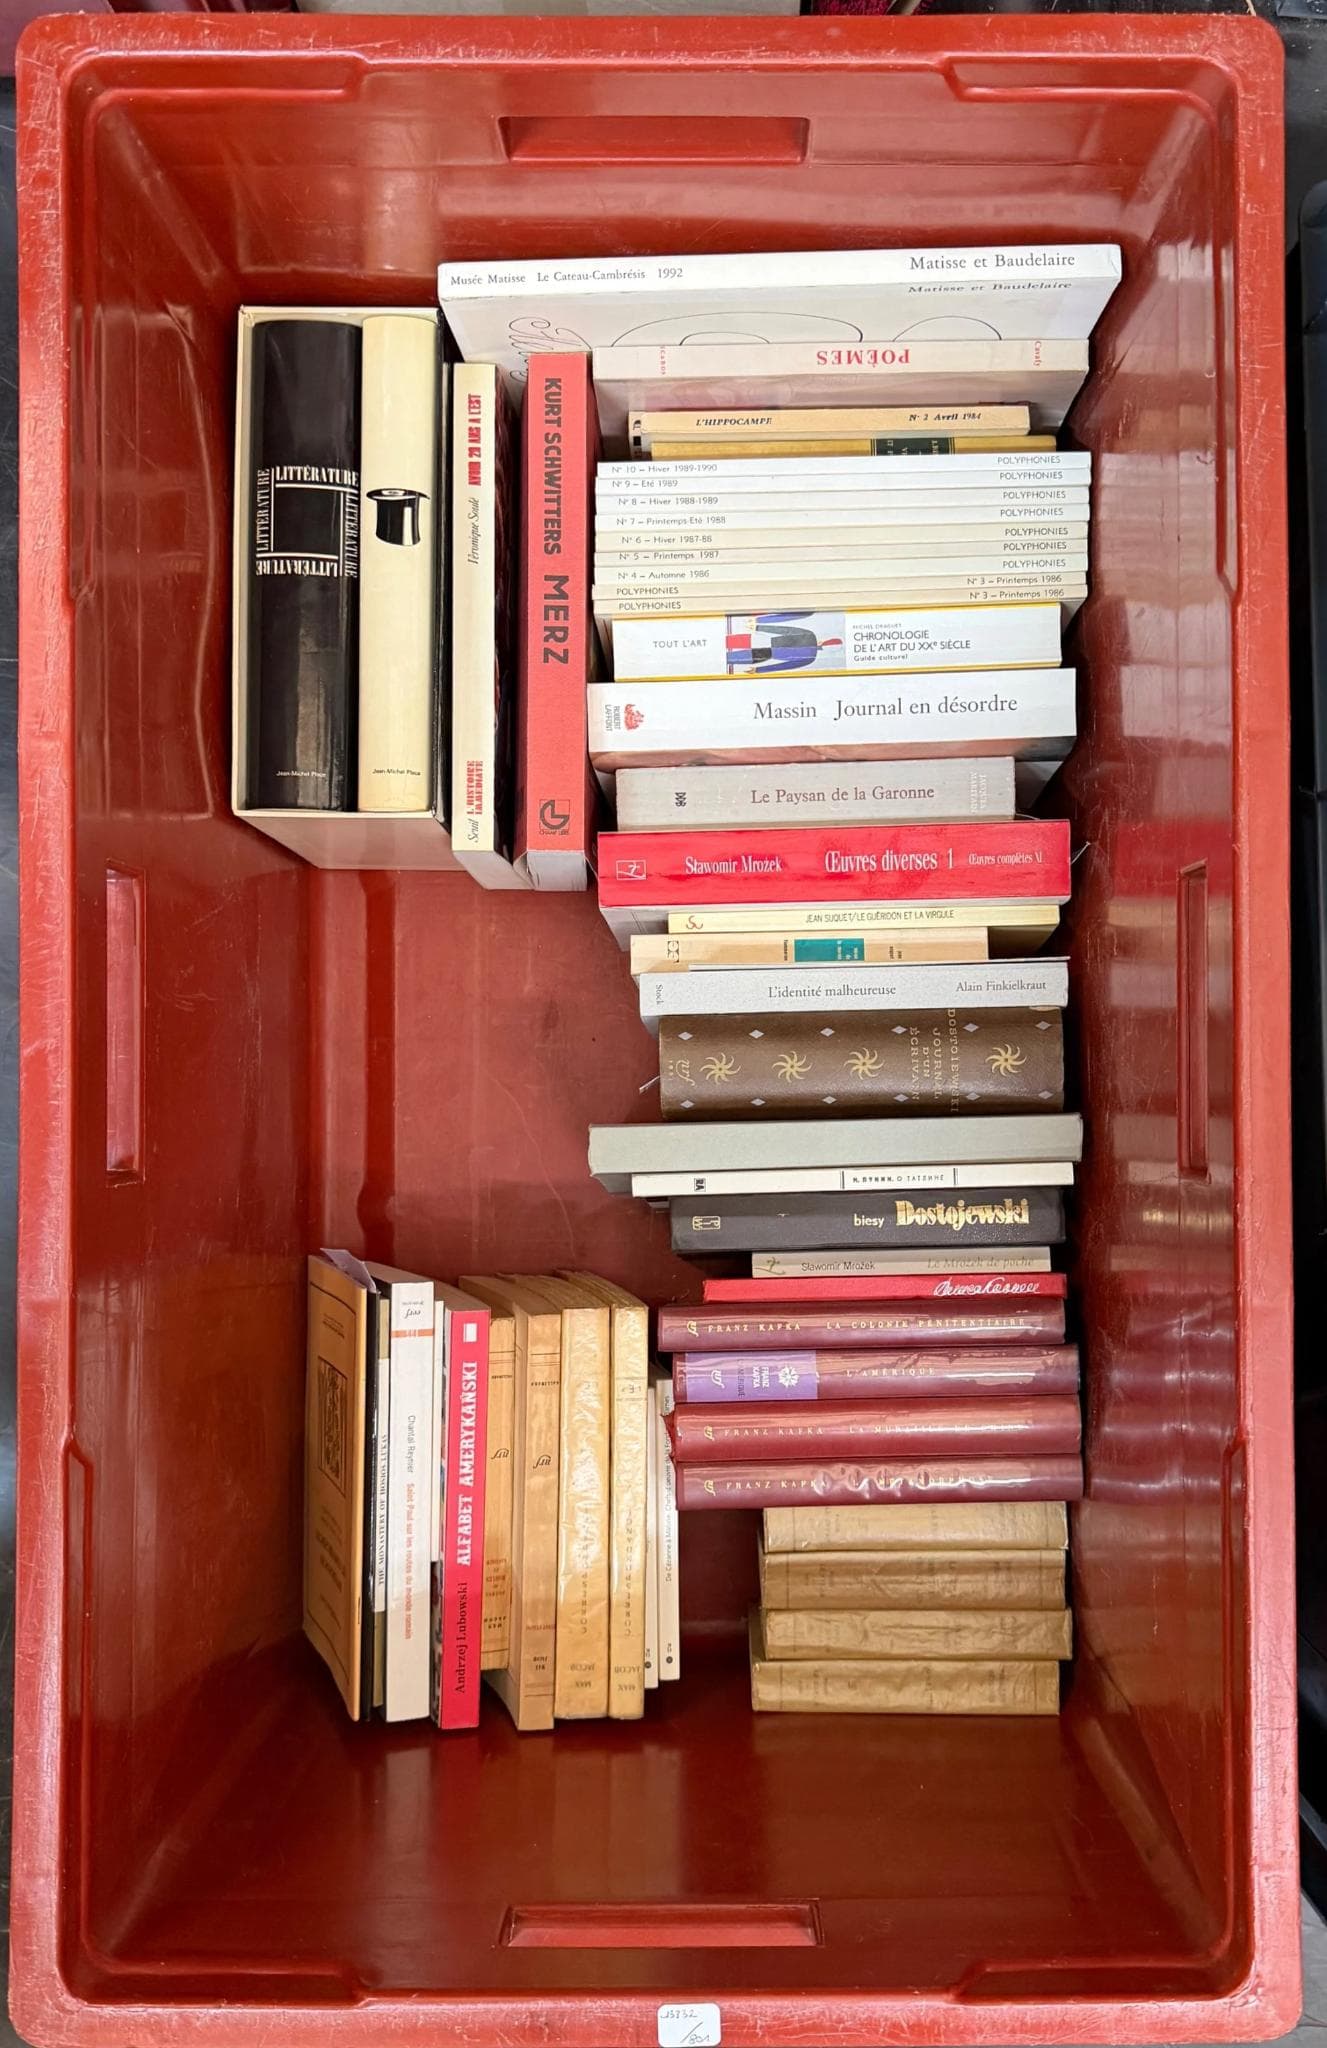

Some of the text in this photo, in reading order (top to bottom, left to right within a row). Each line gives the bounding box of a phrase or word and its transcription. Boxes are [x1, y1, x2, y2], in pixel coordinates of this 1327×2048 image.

[910, 253, 1075, 270] Matisse et Baudelaire
[451, 267, 683, 286] Musée Matisse Le Cateau-Cambrésis 1992
[816, 349, 910, 368] POÈMES
[696, 417, 772, 427] L'HIPPOCAMPE
[934, 411, 981, 421] Avril 1984
[468, 426, 482, 445] ANS
[468, 447, 481, 458] 20
[997, 456, 1061, 464] POLYPHONIES
[544, 378, 562, 555] KURT SCHWITTERS
[648, 465, 670, 473] Hiver
[674, 464, 718, 472] 1989-1990
[276, 465, 359, 487] LITTÉRATURE
[1000, 471, 1063, 480] POLYPHONIES
[625, 480, 631, 488] 9
[658, 479, 678, 487] 1989
[649, 497, 671, 505] Hiver
[1003, 491, 1066, 499] POLYPHONIES
[256, 468, 270, 551] LITTÉRATURE
[1000, 508, 1064, 517] POLYPHONIES
[706, 516, 726, 524] 1988
[467, 498, 481, 565] Véronique Soulé
[1005, 527, 1068, 536] POLYPHONIES
[636, 536, 641, 544] 6
[653, 535, 676, 543] Hiver
[1004, 542, 1067, 551] POLYPHONIES
[653, 551, 694, 561] Printemps
[700, 551, 719, 559] 1987
[256, 559, 337, 577] LITTÉRATURE
[1002, 559, 1066, 568] POLYPHONIES
[648, 571, 686, 579] Automne
[690, 570, 709, 578] 1986
[996, 575, 1062, 585] Printemps 1986
[616, 587, 679, 595] POLYPHONIES
[1000, 589, 1064, 599] Printemps 1986
[619, 601, 681, 611] POLYPHONIES
[543, 575, 569, 664] MERZ
[853, 630, 929, 641] CHRONOLOGIE
[653, 639, 707, 648] TOUT L'ART
[854, 644, 867, 653] DE
[900, 642, 915, 651] DU
[940, 639, 970, 649] SIÈCLE
[753, 694, 1018, 720] Massin Journal en désordre
[751, 786, 935, 805] Le Paysan de la Garonne
[467, 818, 479, 843] Seuil
[825, 848, 953, 873] Œuvres diverses 1
[806, 913, 822, 923] JEAN
[904, 911, 912, 919] ET
[914, 911, 924, 919] LA
[925, 910, 954, 919] VIRGULE
[768, 983, 896, 998] L'identité malheureuse
[955, 979, 1046, 992] Alain Finkielkraut
[922, 1047, 930, 1078] D'UN
[933, 1027, 943, 1099] JOURNAL
[895, 1198, 1029, 1231] Dostojewski
[854, 1214, 884, 1229] biesy
[708, 1323, 800, 1333] FRANZ KAFKA
[851, 1319, 908, 1329] COLONIE
[457, 1361, 478, 1566] ALFABET AMERYKAŃSKI
[726, 1481, 771, 1489] FRANZ
[406, 1483, 415, 1502] Saint
[379, 1499, 386, 1510] OF
[406, 1504, 415, 1521] Paul
[405, 1550, 413, 1574] routes
[405, 1576, 413, 1585] du
[405, 1587, 413, 1612] monde
[455, 1582, 467, 1693] Andrzej Lubowski
